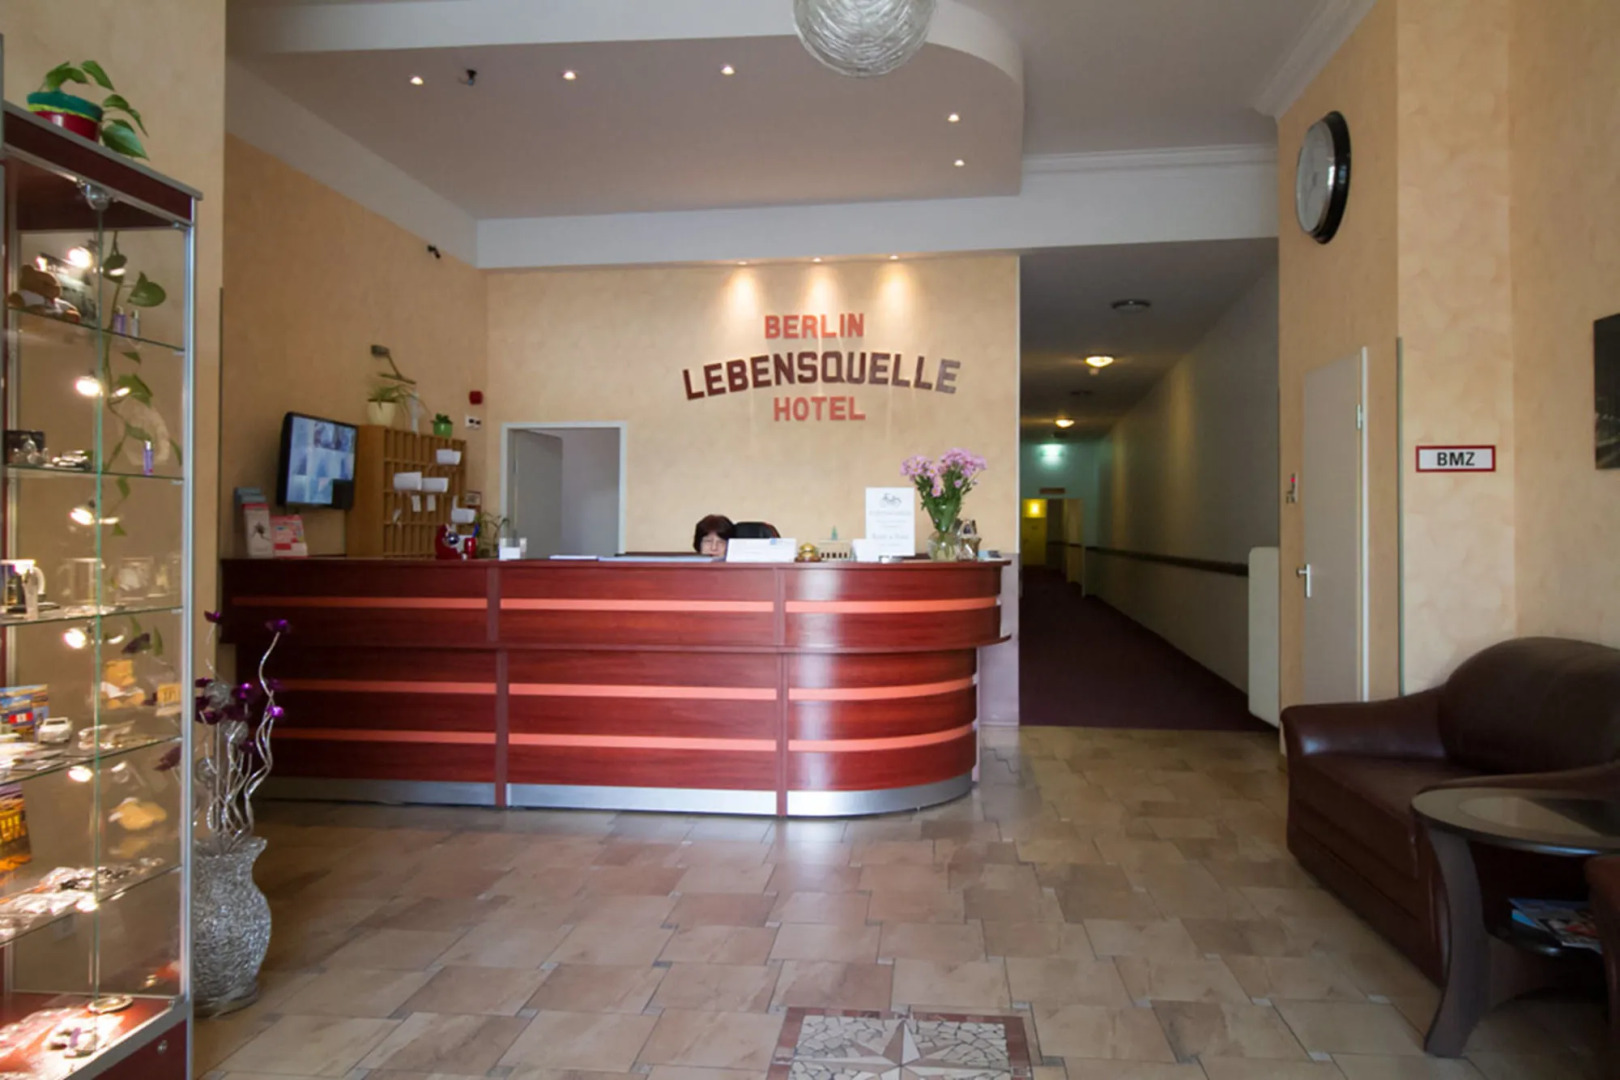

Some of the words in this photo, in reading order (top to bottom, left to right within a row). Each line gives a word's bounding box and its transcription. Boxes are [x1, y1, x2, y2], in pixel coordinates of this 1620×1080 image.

[764, 313, 865, 339] BERLIN
[682, 351, 961, 400] LEBENSQUELLE
[773, 396, 866, 422] HOTEL
[1436, 451, 1476, 467] BMZ
